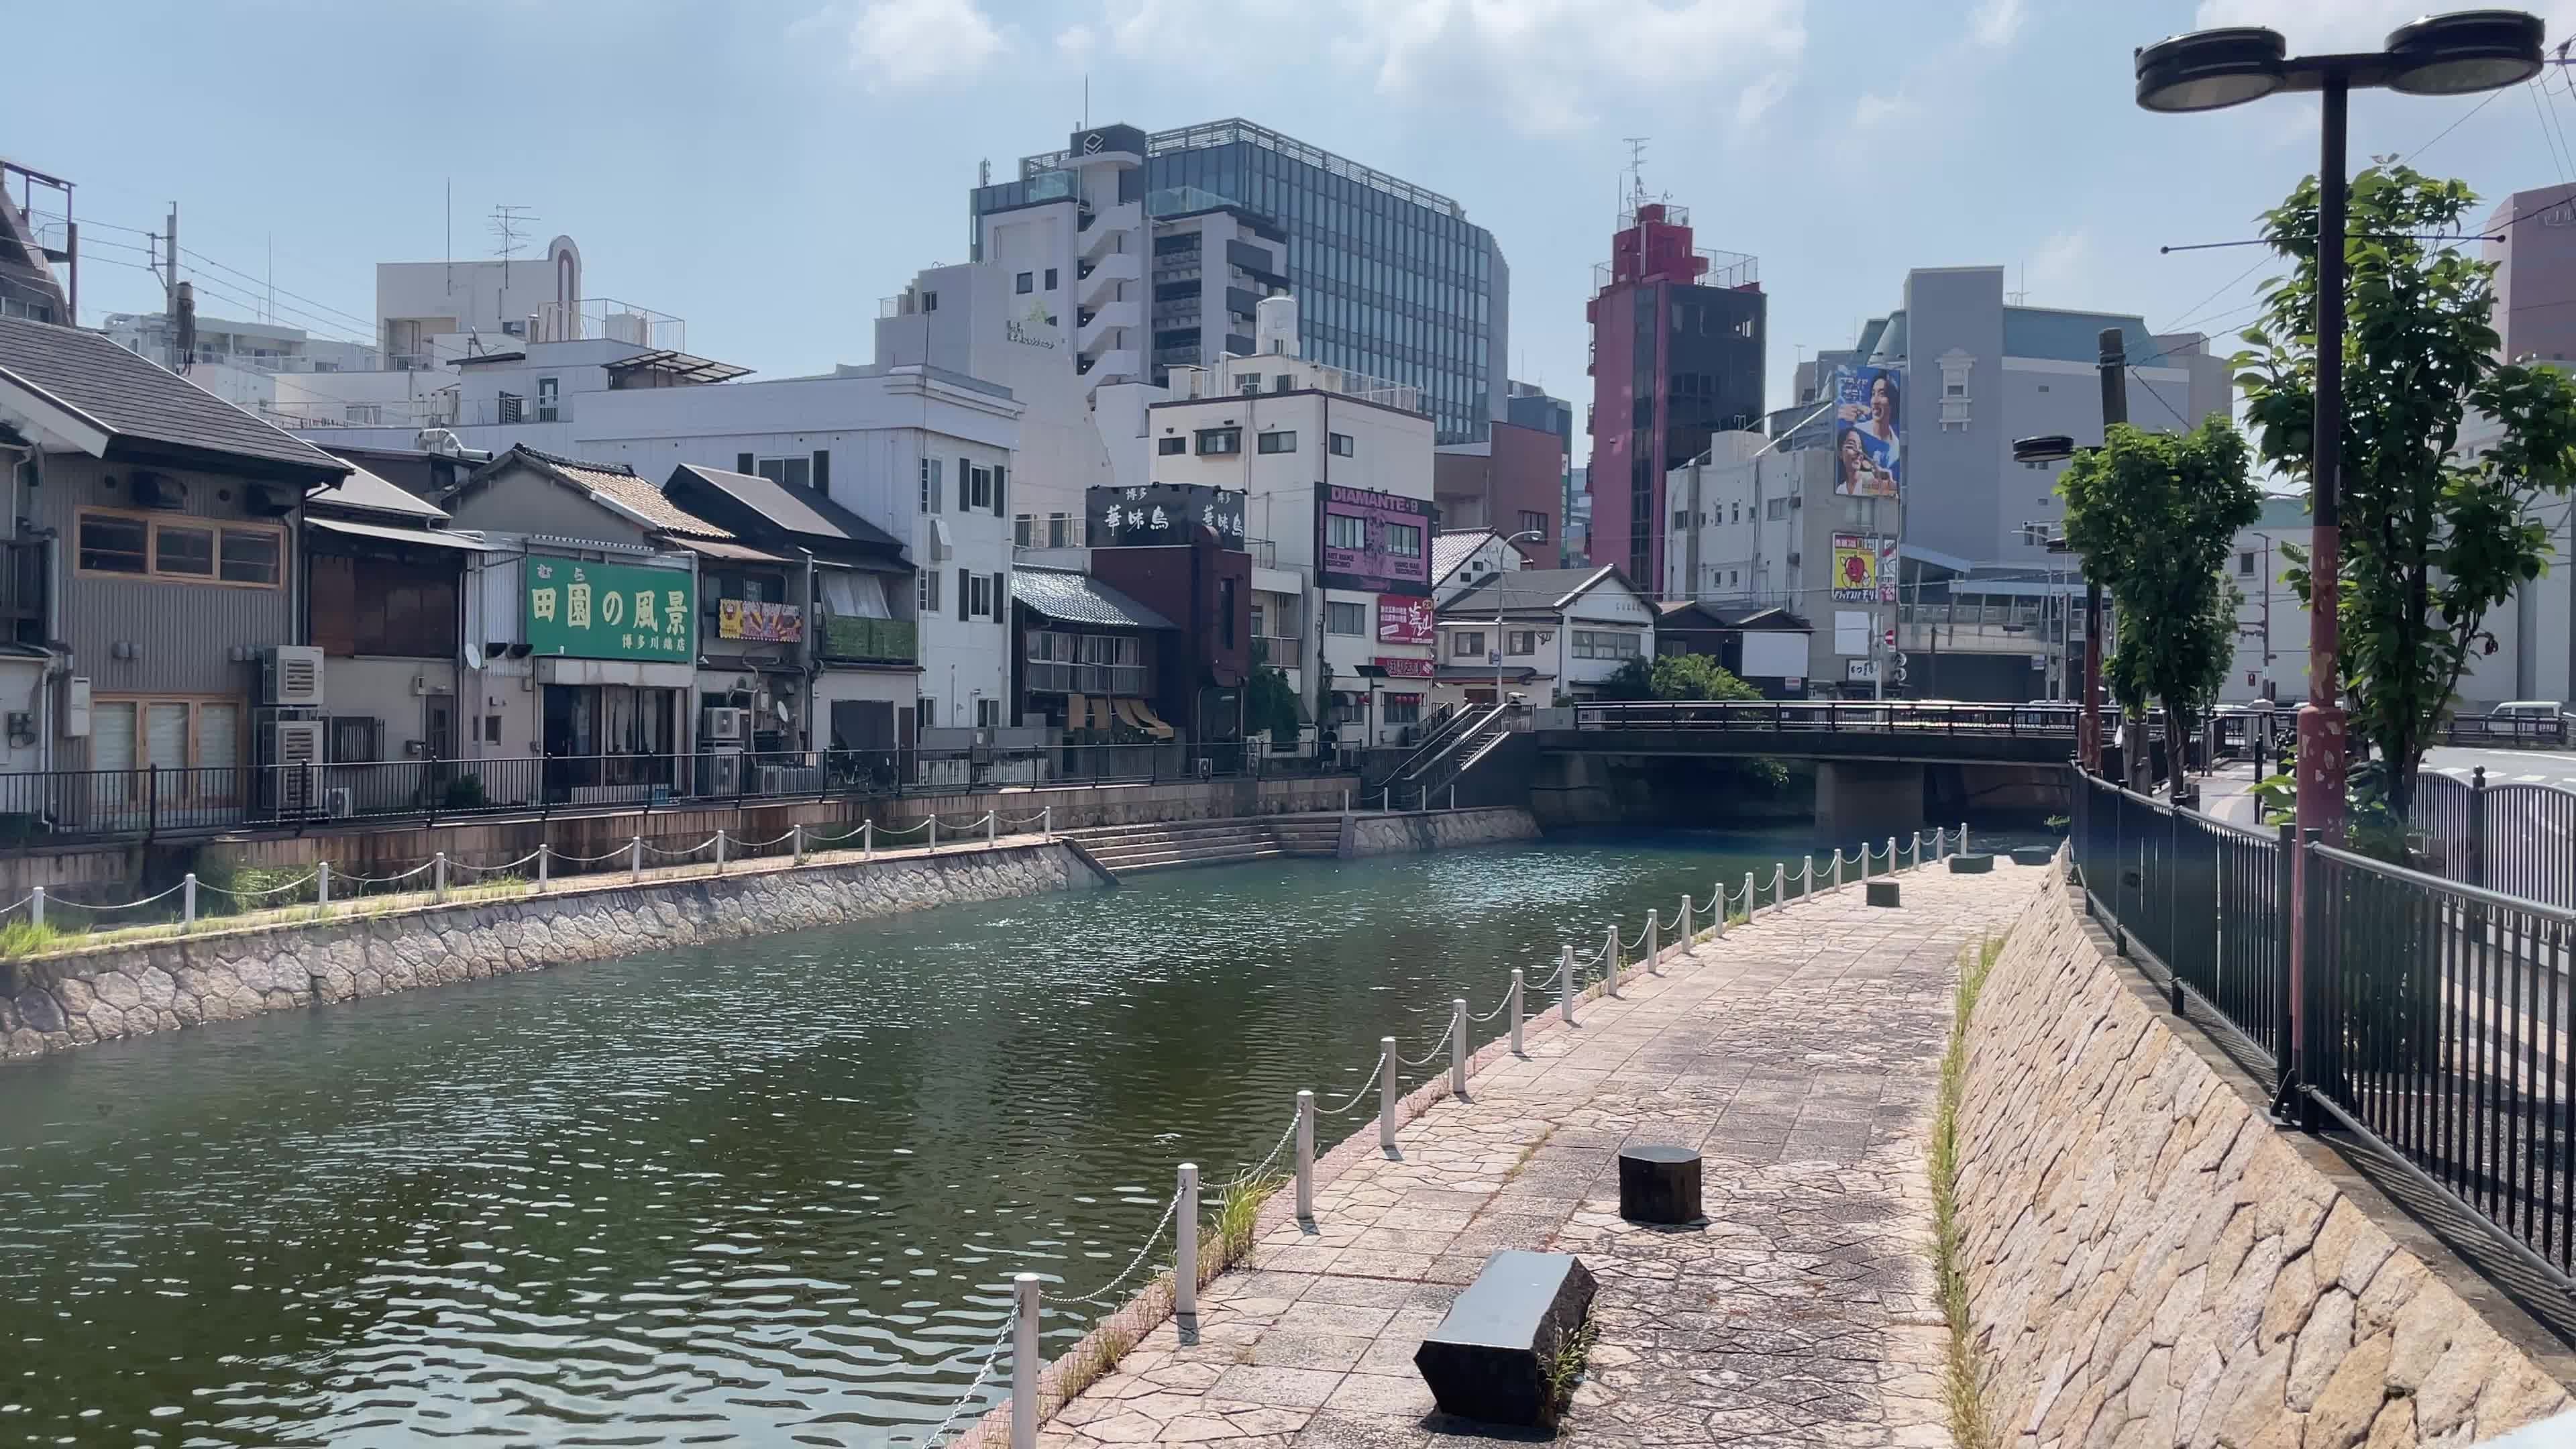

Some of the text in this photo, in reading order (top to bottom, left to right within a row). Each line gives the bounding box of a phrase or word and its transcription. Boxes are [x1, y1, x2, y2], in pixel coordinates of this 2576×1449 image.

[1126, 488, 1147, 500] 博多
[1105, 504, 1169, 536] 華味鳥
[532, 583, 688, 635] 田園の風景
[623, 634, 686, 652] 博多川端店
